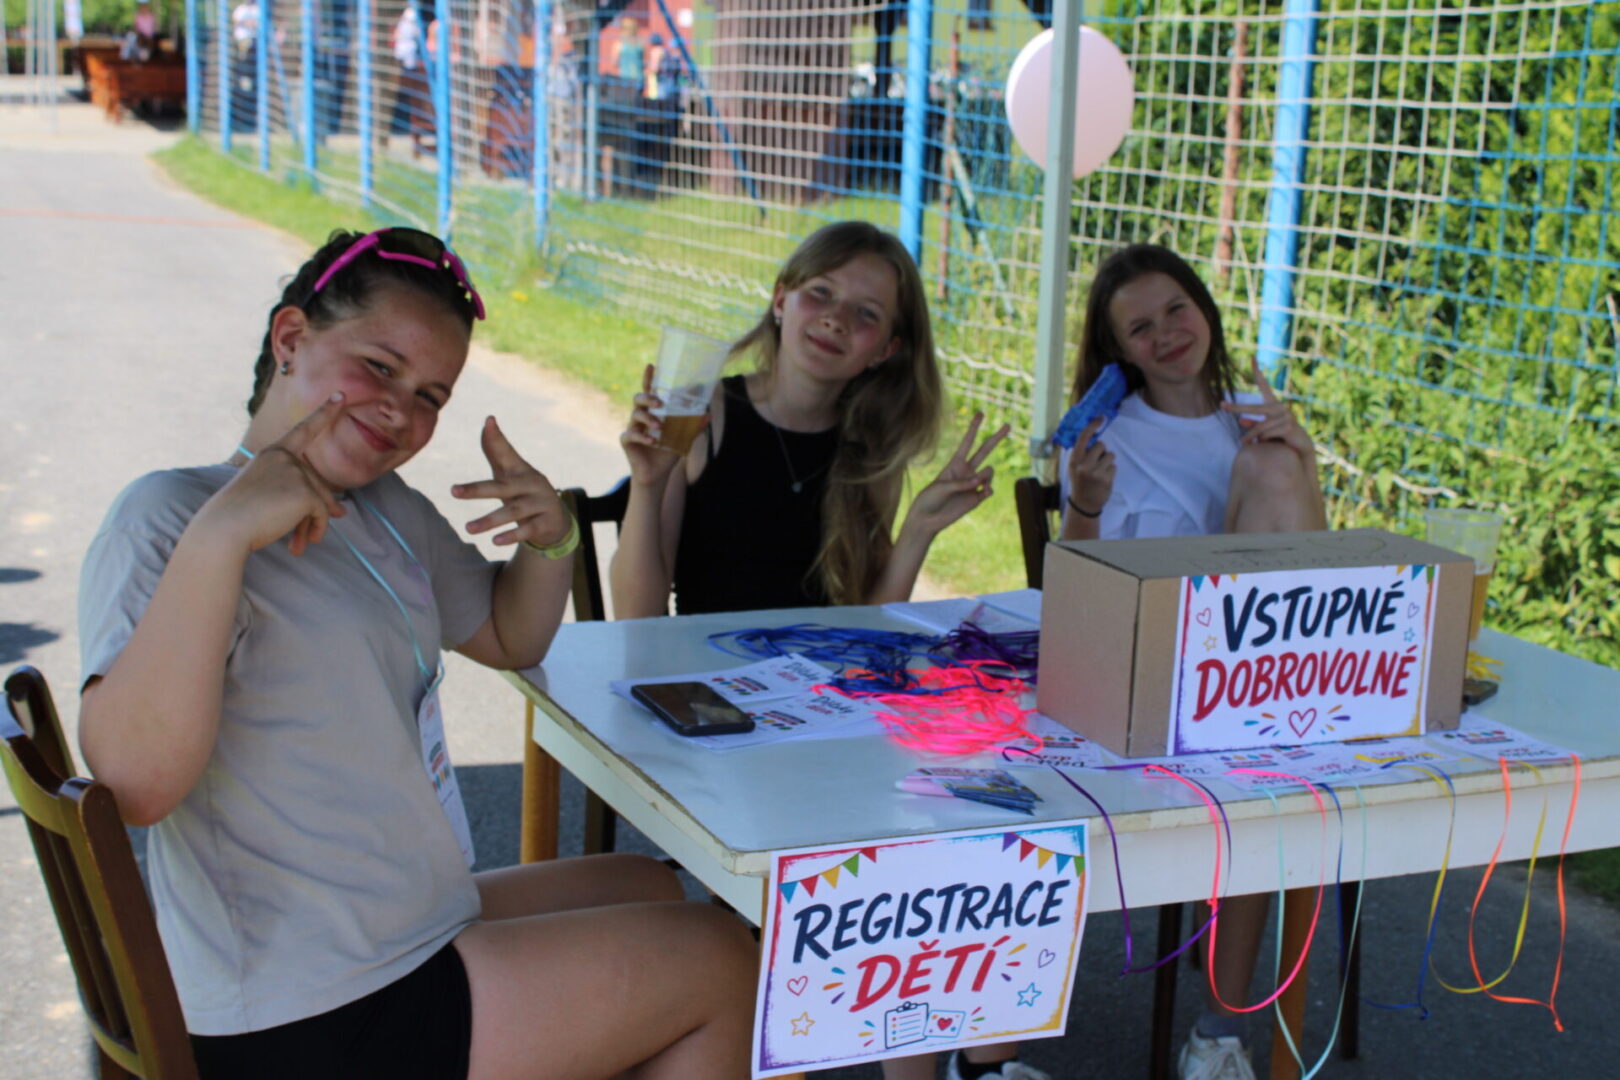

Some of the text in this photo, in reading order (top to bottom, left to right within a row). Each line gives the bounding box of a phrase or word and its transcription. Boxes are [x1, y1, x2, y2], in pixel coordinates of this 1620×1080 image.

[1223, 580, 1404, 653] VSTUPNÉ
[1192, 645, 1418, 722] DOBROVOLNÉ
[793, 879, 1070, 963] REGISTRACE
[849, 935, 1011, 1012] DĚTÍ
